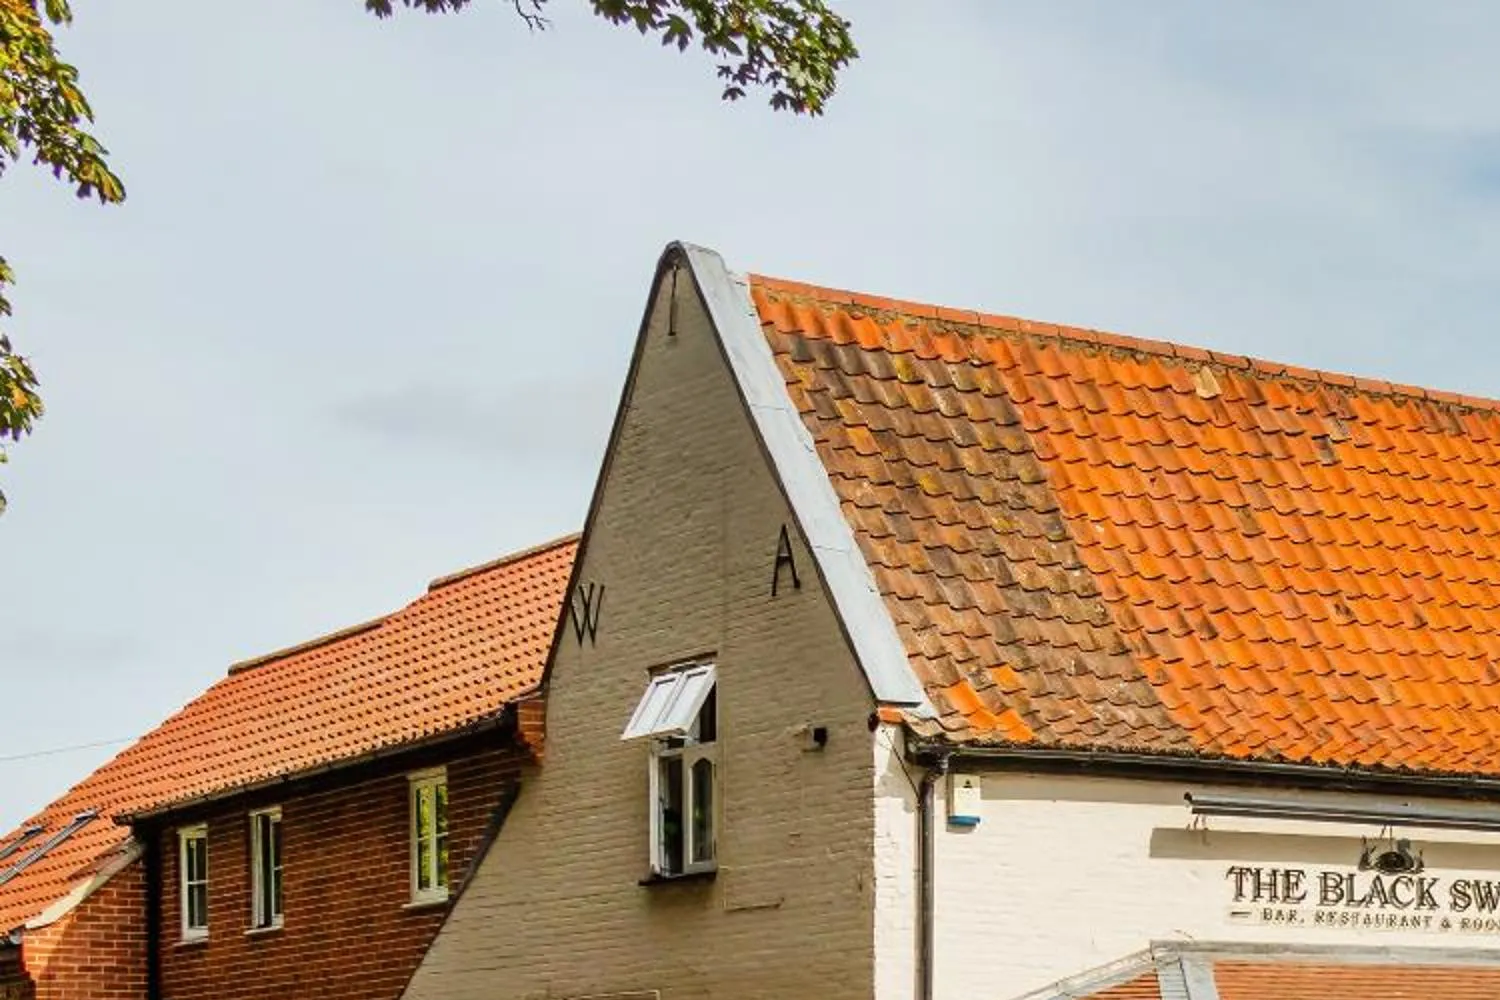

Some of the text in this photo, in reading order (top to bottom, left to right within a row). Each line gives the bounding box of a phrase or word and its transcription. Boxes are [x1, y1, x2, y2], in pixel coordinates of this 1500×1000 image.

[1225, 866, 1308, 904] THE
[1316, 871, 1440, 910] BLACK
[1315, 911, 1433, 929] RESTAURANT
[1440, 916, 1452, 929] &
